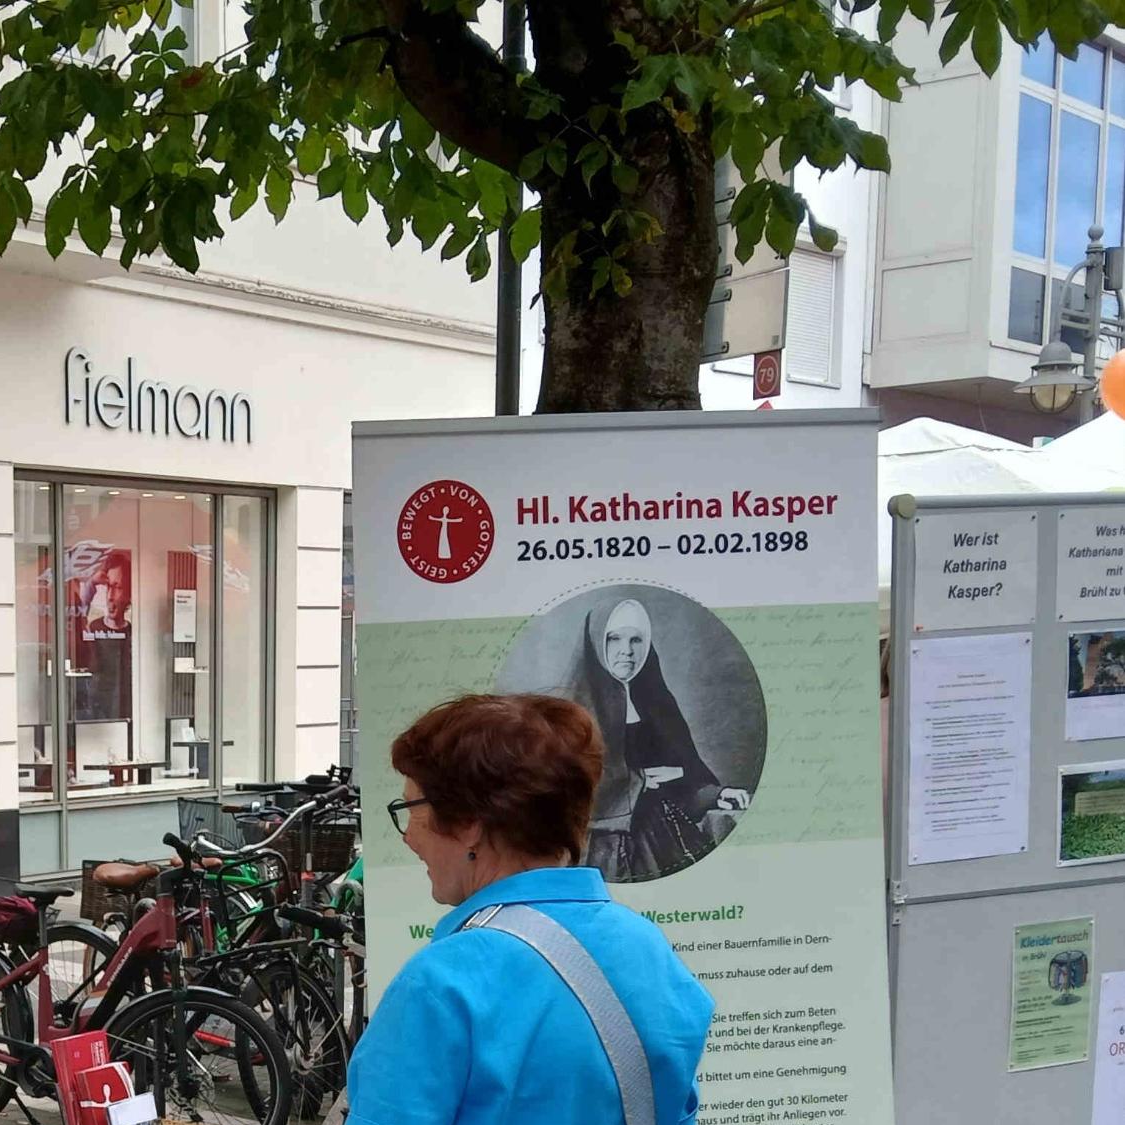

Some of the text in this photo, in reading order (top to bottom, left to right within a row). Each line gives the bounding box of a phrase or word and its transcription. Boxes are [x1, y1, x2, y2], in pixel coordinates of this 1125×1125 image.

[758, 365, 775, 385] 79
[450, 485, 479, 507] VON
[402, 487, 436, 540] BEWEGT
[516, 489, 839, 525] Hl. Katharina Kasper
[953, 531, 1000, 547] Wer ist
[1096, 525, 1118, 537] Was
[462, 520, 490, 572] GOTTES
[517, 530, 809, 562] 26.05.1820 02.02.1898
[409, 555, 447, 579] GEIST
[943, 557, 1007, 574] Katharina
[1106, 565, 1124, 577] mit
[948, 582, 1003, 601] Kasper?
[1079, 585, 1108, 598] Brühl
[1109, 587, 1122, 597] zu
[641, 905, 745, 925] Westerwald?
[672, 934, 833, 953] Kind einer Bauernfamilie in Dern-
[1019, 929, 1090, 949] Kleidertausch
[698, 970, 724, 981] muss
[726, 968, 766, 980] zuhause
[768, 965, 792, 976] oder
[793, 963, 810, 975] auf
[811, 963, 834, 974] dem
[712, 1006, 837, 1024] Sie treffen sich zum Beten
[715, 1026, 735, 1038] und
[736, 1024, 752, 1037] bei
[754, 1023, 770, 1035] der
[772, 1020, 847, 1034] Krankenpflege.
[706, 1042, 722, 1053] Sie
[723, 1038, 761, 1052] möchte
[762, 1038, 796, 1049] daraus
[797, 1036, 819, 1048] eine
[705, 1064, 848, 1083] bittet um eine Genehmigung
[710, 1093, 849, 1112] wieder den gut 30 Kilometer
[720, 1107, 848, 1125] und trägt ihr Anliegen vor.
